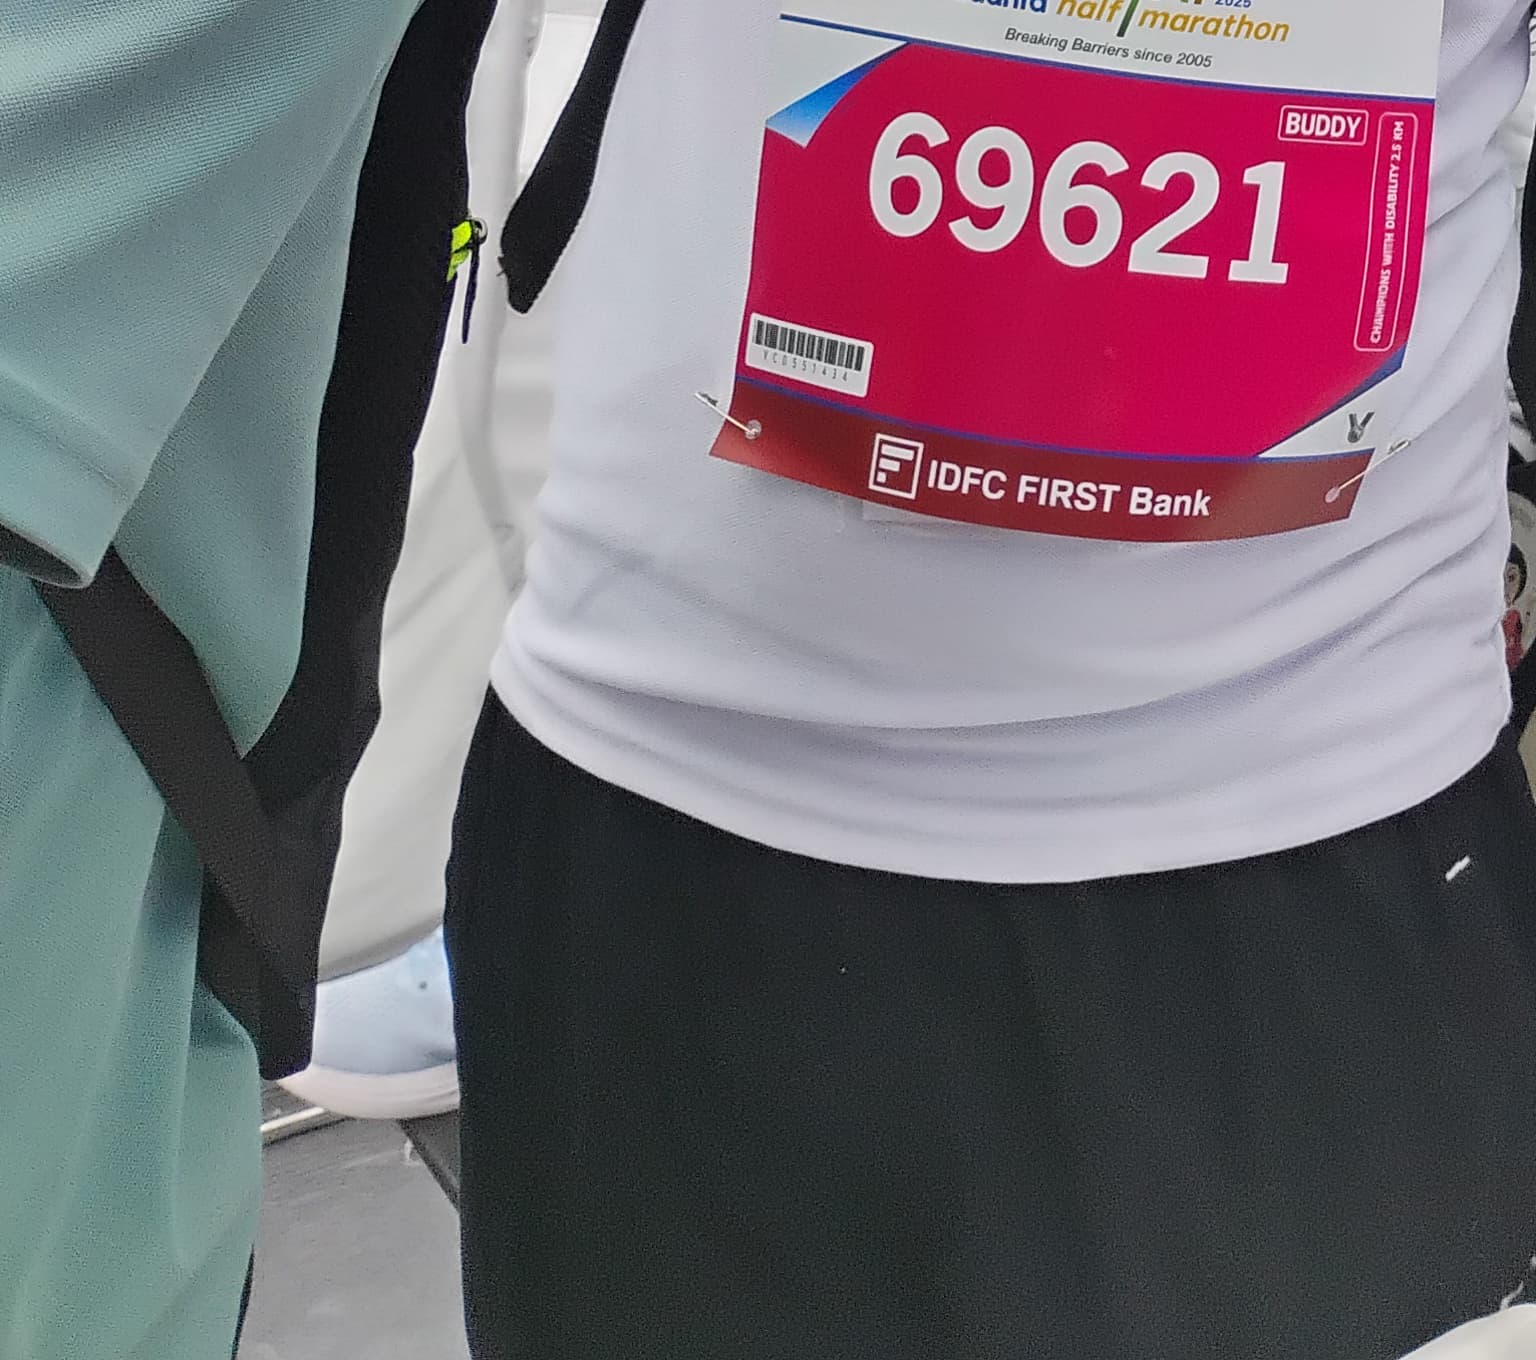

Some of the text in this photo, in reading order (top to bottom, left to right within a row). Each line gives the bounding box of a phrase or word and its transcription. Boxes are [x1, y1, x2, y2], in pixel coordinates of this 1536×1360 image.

[1004, 26, 1213, 69] Breaking Barriers since 2005
[1138, 6, 1291, 43] marathon
[1285, 111, 1364, 141] BUDDY
[868, 111, 1290, 285] 69621
[1369, 120, 1405, 346] CHAMPIONS WITH DISABILITY 2.5 KM
[926, 458, 1213, 518] IDFC FIRST Bank
